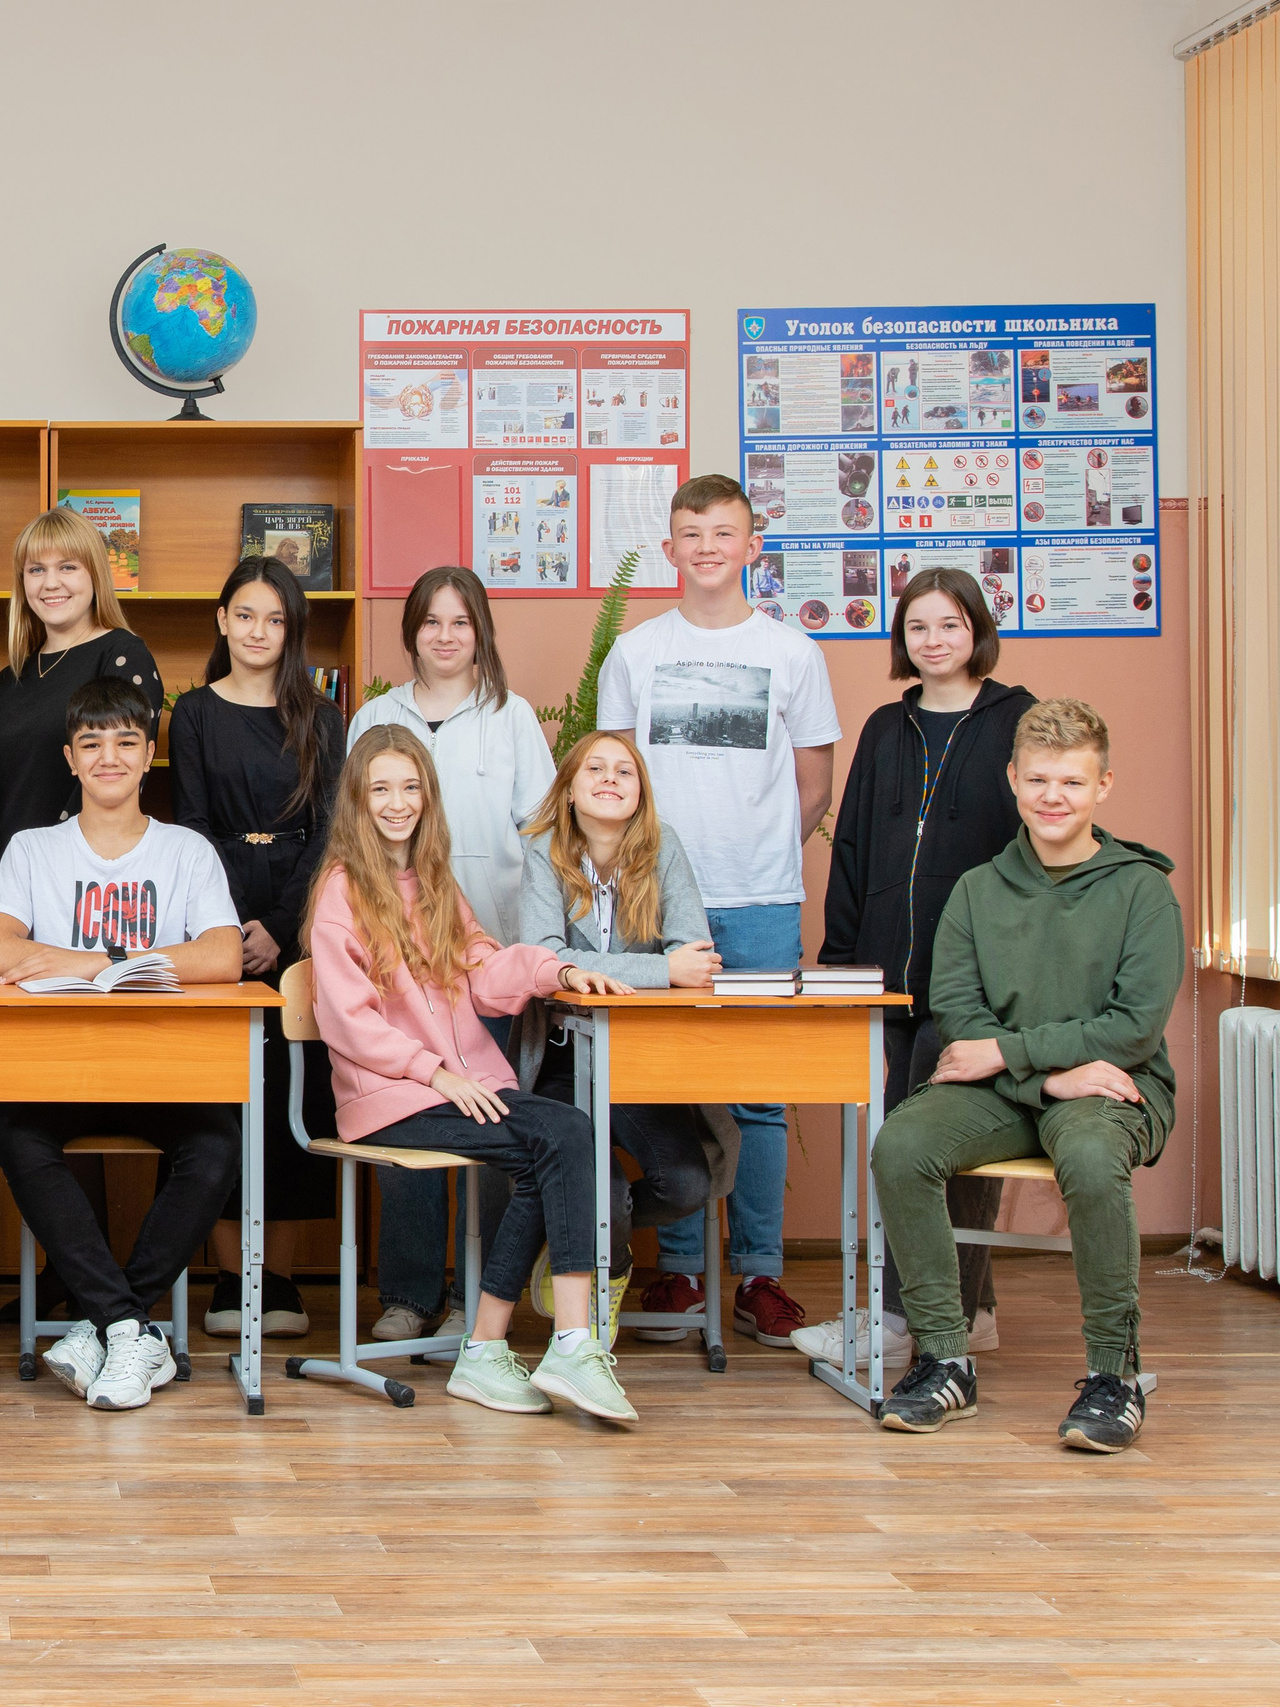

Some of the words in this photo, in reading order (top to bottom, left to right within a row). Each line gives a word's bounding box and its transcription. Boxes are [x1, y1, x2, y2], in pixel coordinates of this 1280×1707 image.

[387, 319, 500, 335] ПОЖАРНАЯ
[505, 319, 663, 335] БЕЗОПАСНОСТЬ
[785, 319, 854, 336] Уголок
[862, 316, 997, 335] безопасности
[1004, 317, 1119, 332] школьника
[906, 342, 957, 350] БЕЗОПАСНОСТЬ
[968, 341, 988, 350] ЛЬДУ
[1033, 340, 1065, 348] ПРАВИЛА
[1065, 340, 1105, 348] ПОВЕДЕНИЯ
[1106, 339, 1116, 347] НА
[1116, 339, 1135, 347] ВОДЕ
[755, 345, 788, 353] ОПАСНЫЕ
[789, 345, 832, 353] ПРИРОДНЫЕ
[890, 441, 937, 449] ОБЯЗАТЕЛЬНО
[971, 440, 985, 448] ЭТИ
[1037, 438, 1093, 446] ЭЛЕКТРИЧЕСТВО
[1093, 438, 1120, 446] ВОКРУГ
[755, 443, 786, 451] ПРАВИЛА
[787, 443, 829, 452] ДОРОЖНОГО
[830, 442, 868, 451] ДВИЖЕНИЯ
[504, 486, 521, 494] 101
[484, 496, 496, 504] 01
[504, 496, 521, 504] 112
[989, 497, 1012, 506] ВЫХОД
[265, 516, 284, 524] ЦАРЬ
[285, 515, 312, 523] ЗВЕРЕЙ
[781, 542, 799, 550] ЕСЛИ
[822, 541, 845, 549] УЛИЦЕ
[915, 540, 934, 548] ЕСЛИ
[946, 539, 966, 548] ДОМА
[967, 539, 986, 547] ОДИН
[1035, 538, 1050, 546] АЗЫ
[1051, 537, 1089, 545] ПОЖАРНОЙ
[1089, 537, 1141, 545] БЕЗОПАСНОСТИ
[71, 879, 158, 949] ICONO
